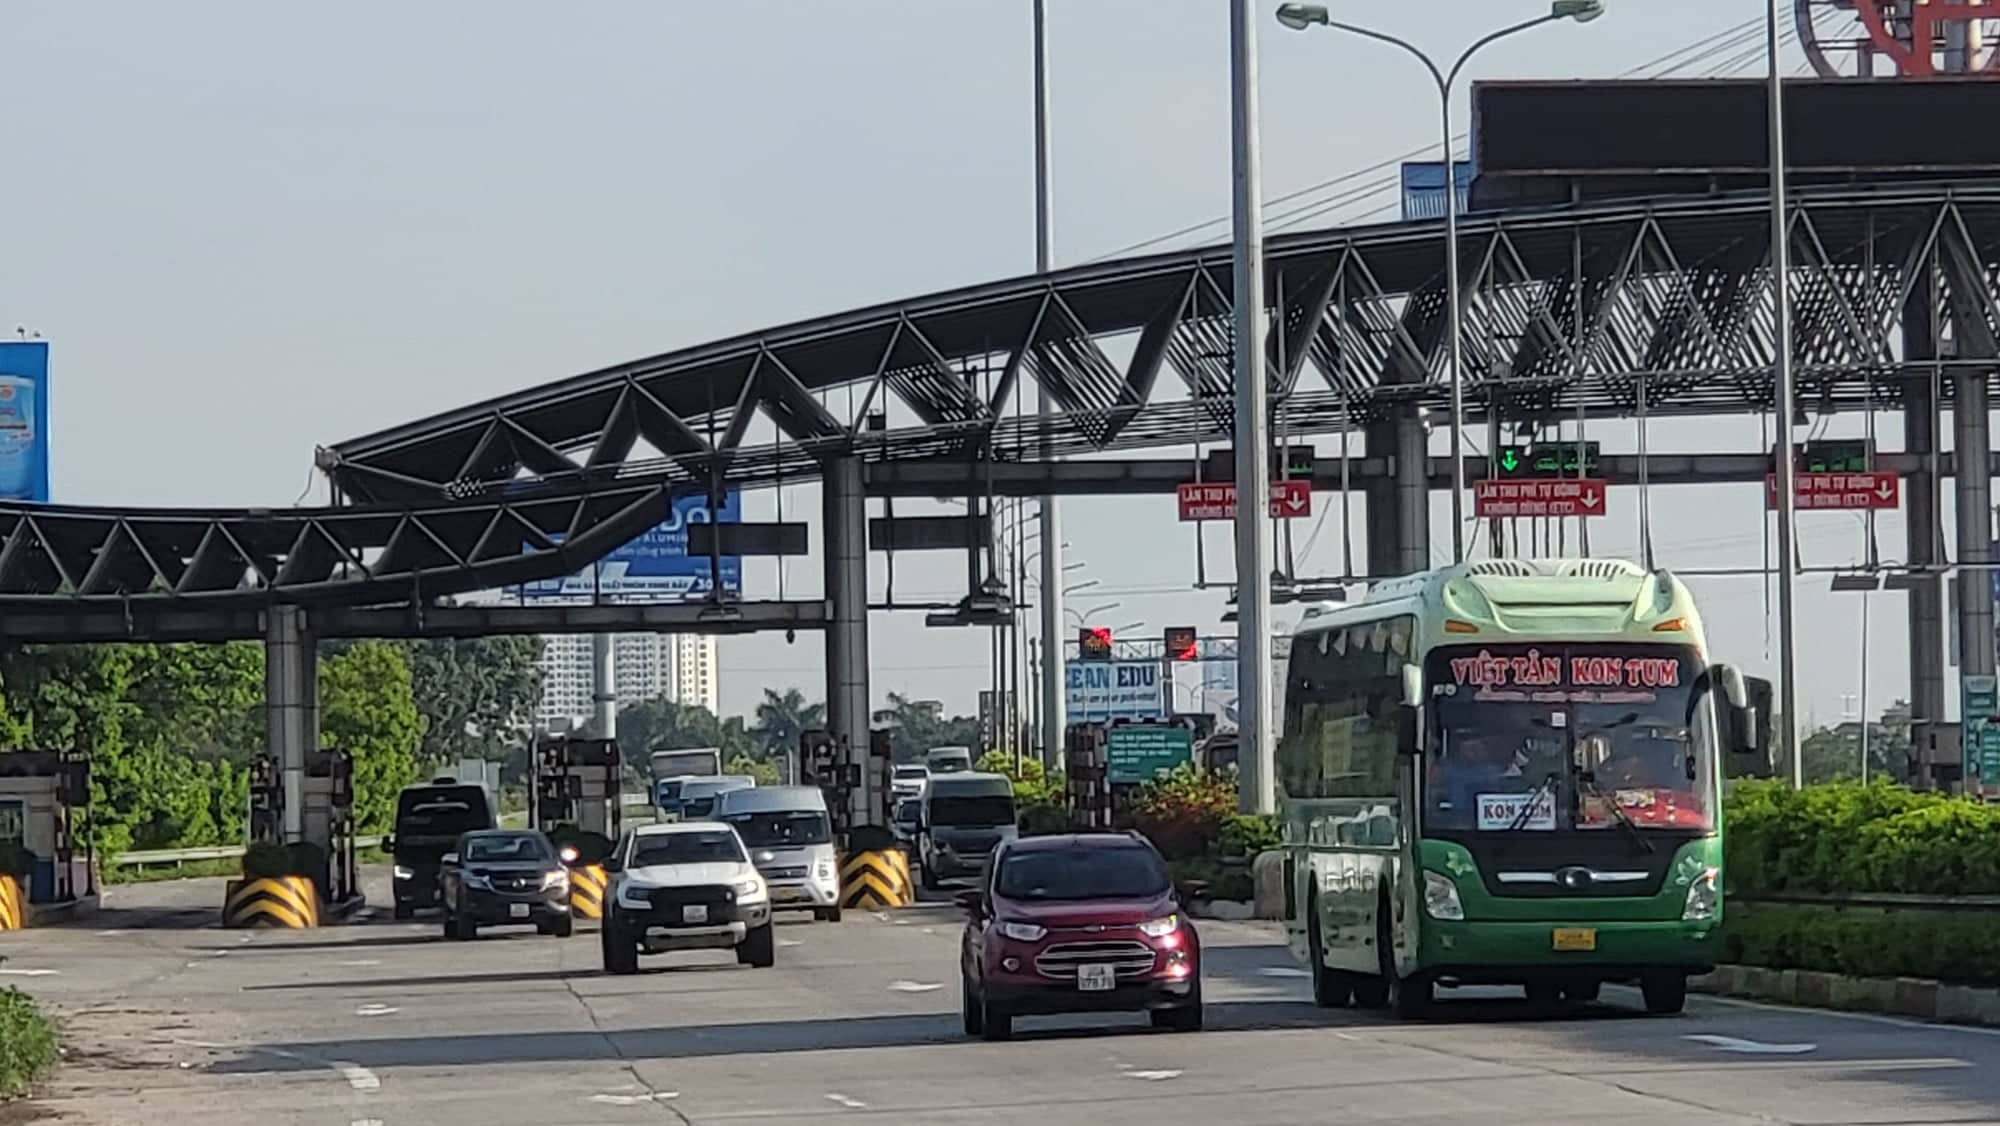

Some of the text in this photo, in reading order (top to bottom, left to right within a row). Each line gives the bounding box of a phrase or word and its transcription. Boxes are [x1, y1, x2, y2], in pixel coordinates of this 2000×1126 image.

[1117, 665, 1155, 687] EDU
[1571, 657, 1622, 686] KON
[1624, 658, 1679, 687] TUM
[1484, 804, 1514, 819] KON
